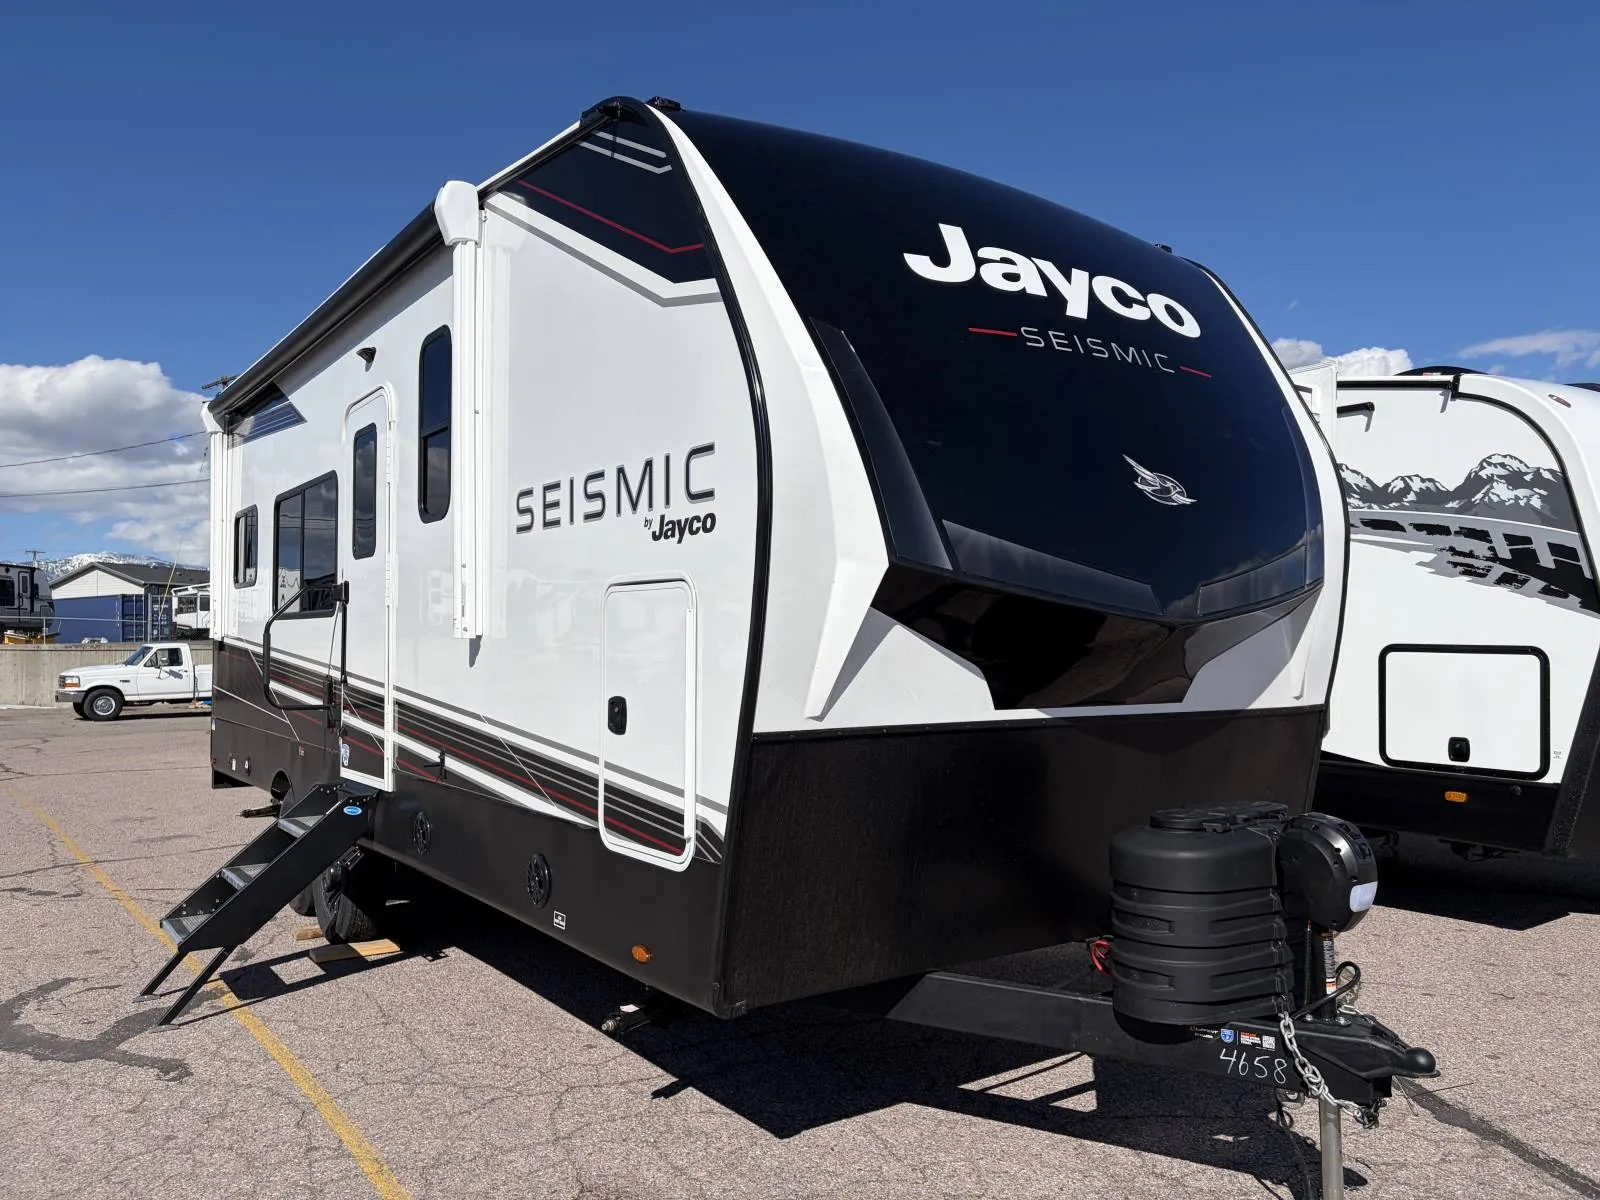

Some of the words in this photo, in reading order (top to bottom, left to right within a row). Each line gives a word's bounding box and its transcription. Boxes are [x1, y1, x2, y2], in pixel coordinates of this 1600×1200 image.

[902, 222, 1202, 339] Jayco
[1020, 326, 1176, 374] SEISMIC
[515, 441, 716, 535] SEISMIC
[643, 516, 654, 530] by
[651, 512, 717, 545] Jayco
[1219, 1048, 1288, 1084] 4658
